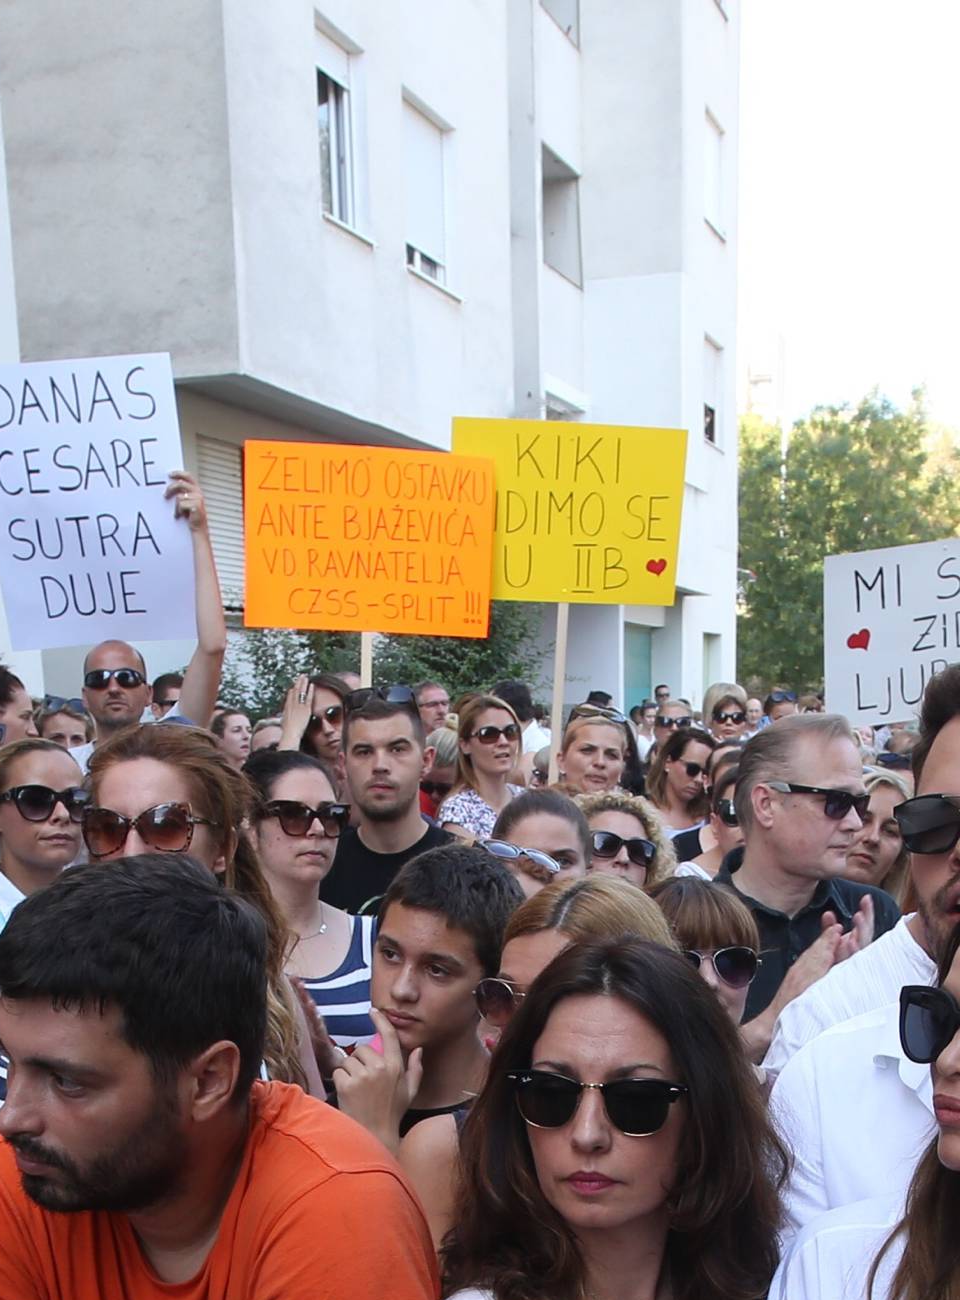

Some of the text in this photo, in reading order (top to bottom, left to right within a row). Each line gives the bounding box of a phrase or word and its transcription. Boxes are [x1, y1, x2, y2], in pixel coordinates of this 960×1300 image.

[383, 460, 488, 506] OSTAVKU
[516, 433, 622, 485] KIKI
[7, 511, 162, 562] SUTRA
[256, 502, 330, 540] ANTE
[622, 494, 670, 542] SE
[262, 548, 465, 586] VD RAVNATELJA
[503, 544, 532, 589] U
[854, 564, 902, 613] MI
[40, 571, 147, 619] DUJE
